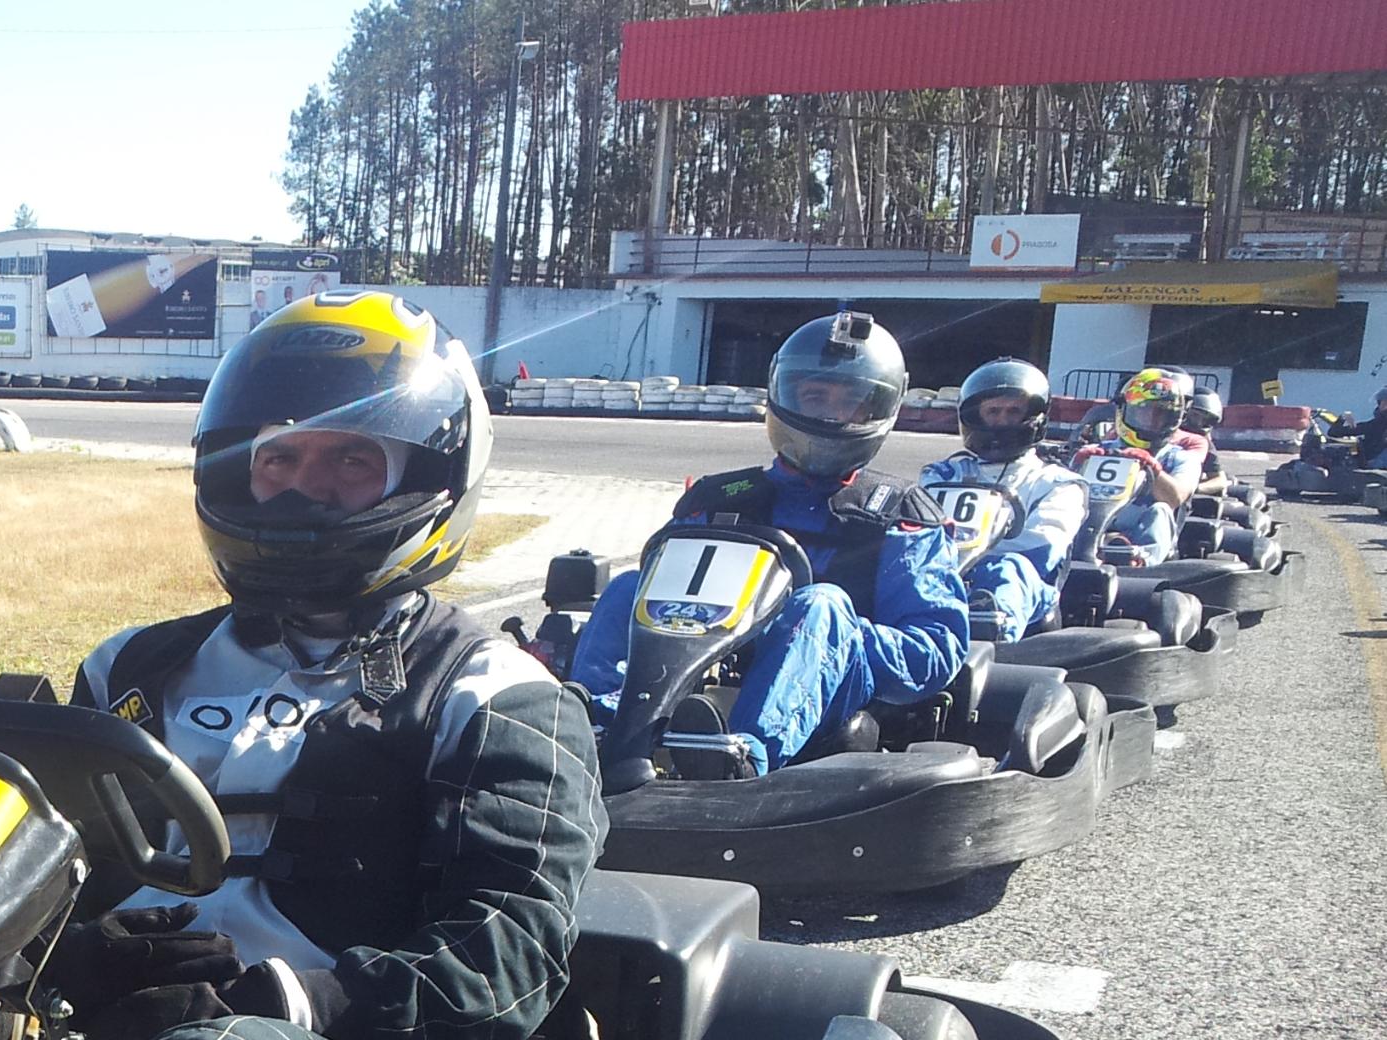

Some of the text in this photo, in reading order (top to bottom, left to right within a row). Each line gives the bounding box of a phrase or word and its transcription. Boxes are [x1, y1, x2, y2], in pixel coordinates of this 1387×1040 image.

[1096, 459, 1121, 482] 6
[686, 545, 718, 596] 1
[113, 696, 141, 720] MP
